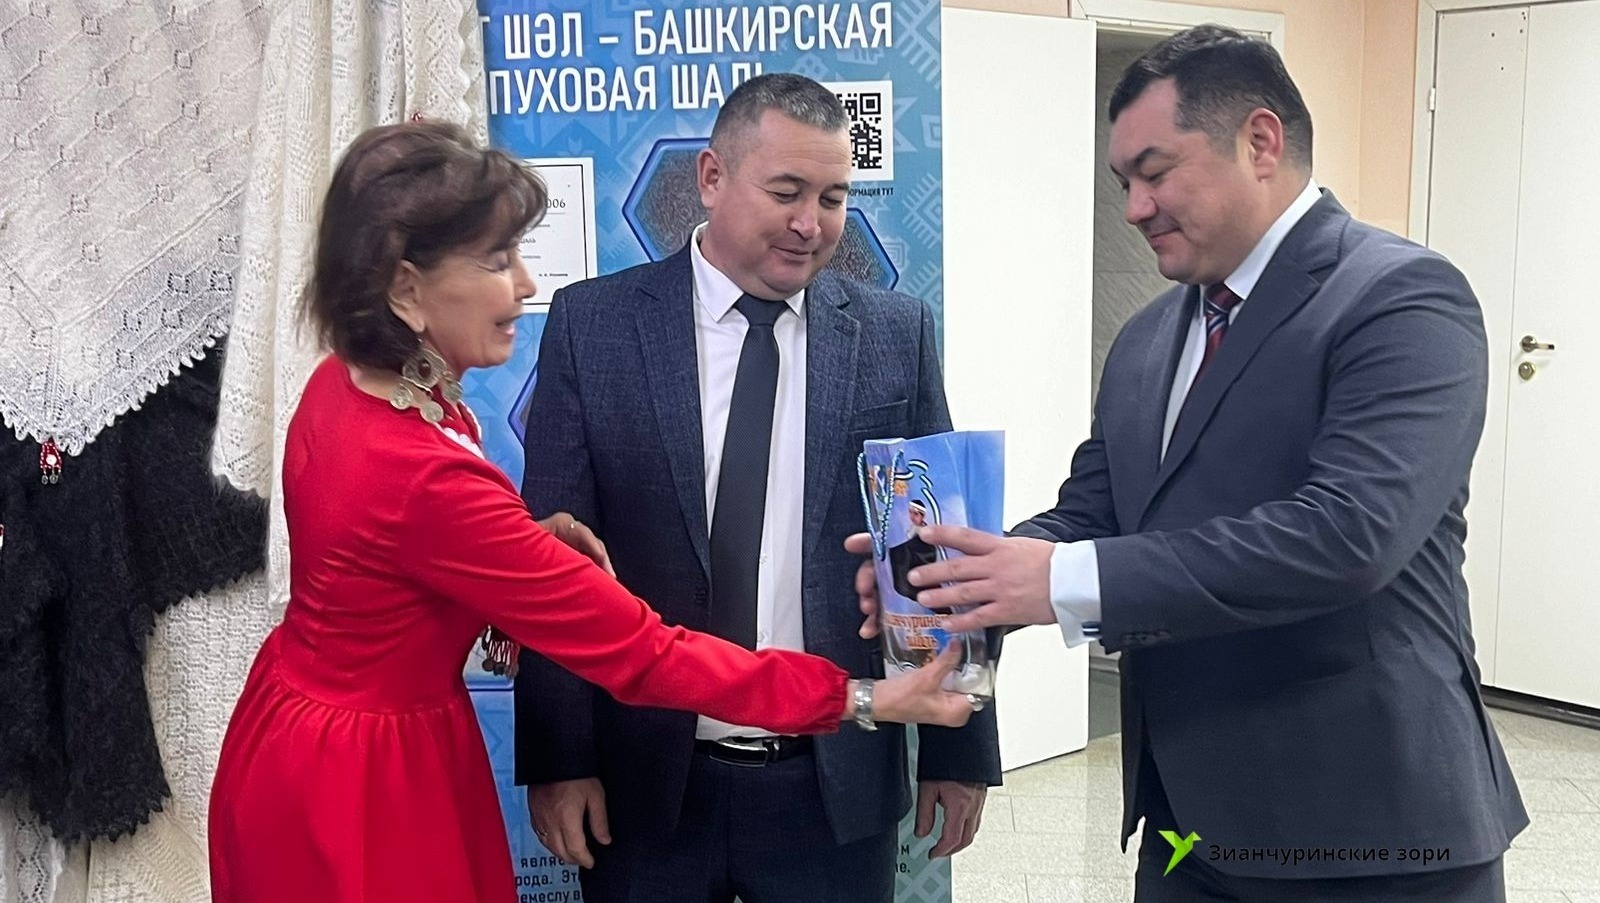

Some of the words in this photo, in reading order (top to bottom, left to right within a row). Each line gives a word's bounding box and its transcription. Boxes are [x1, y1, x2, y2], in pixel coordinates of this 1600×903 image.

[503, 12, 583, 59] ШӘЛ
[634, 2, 893, 56] БАШКИРСКАЯ
[489, 65, 656, 115] ПУХОВАЯ
[671, 62, 762, 110] ШАЛ
